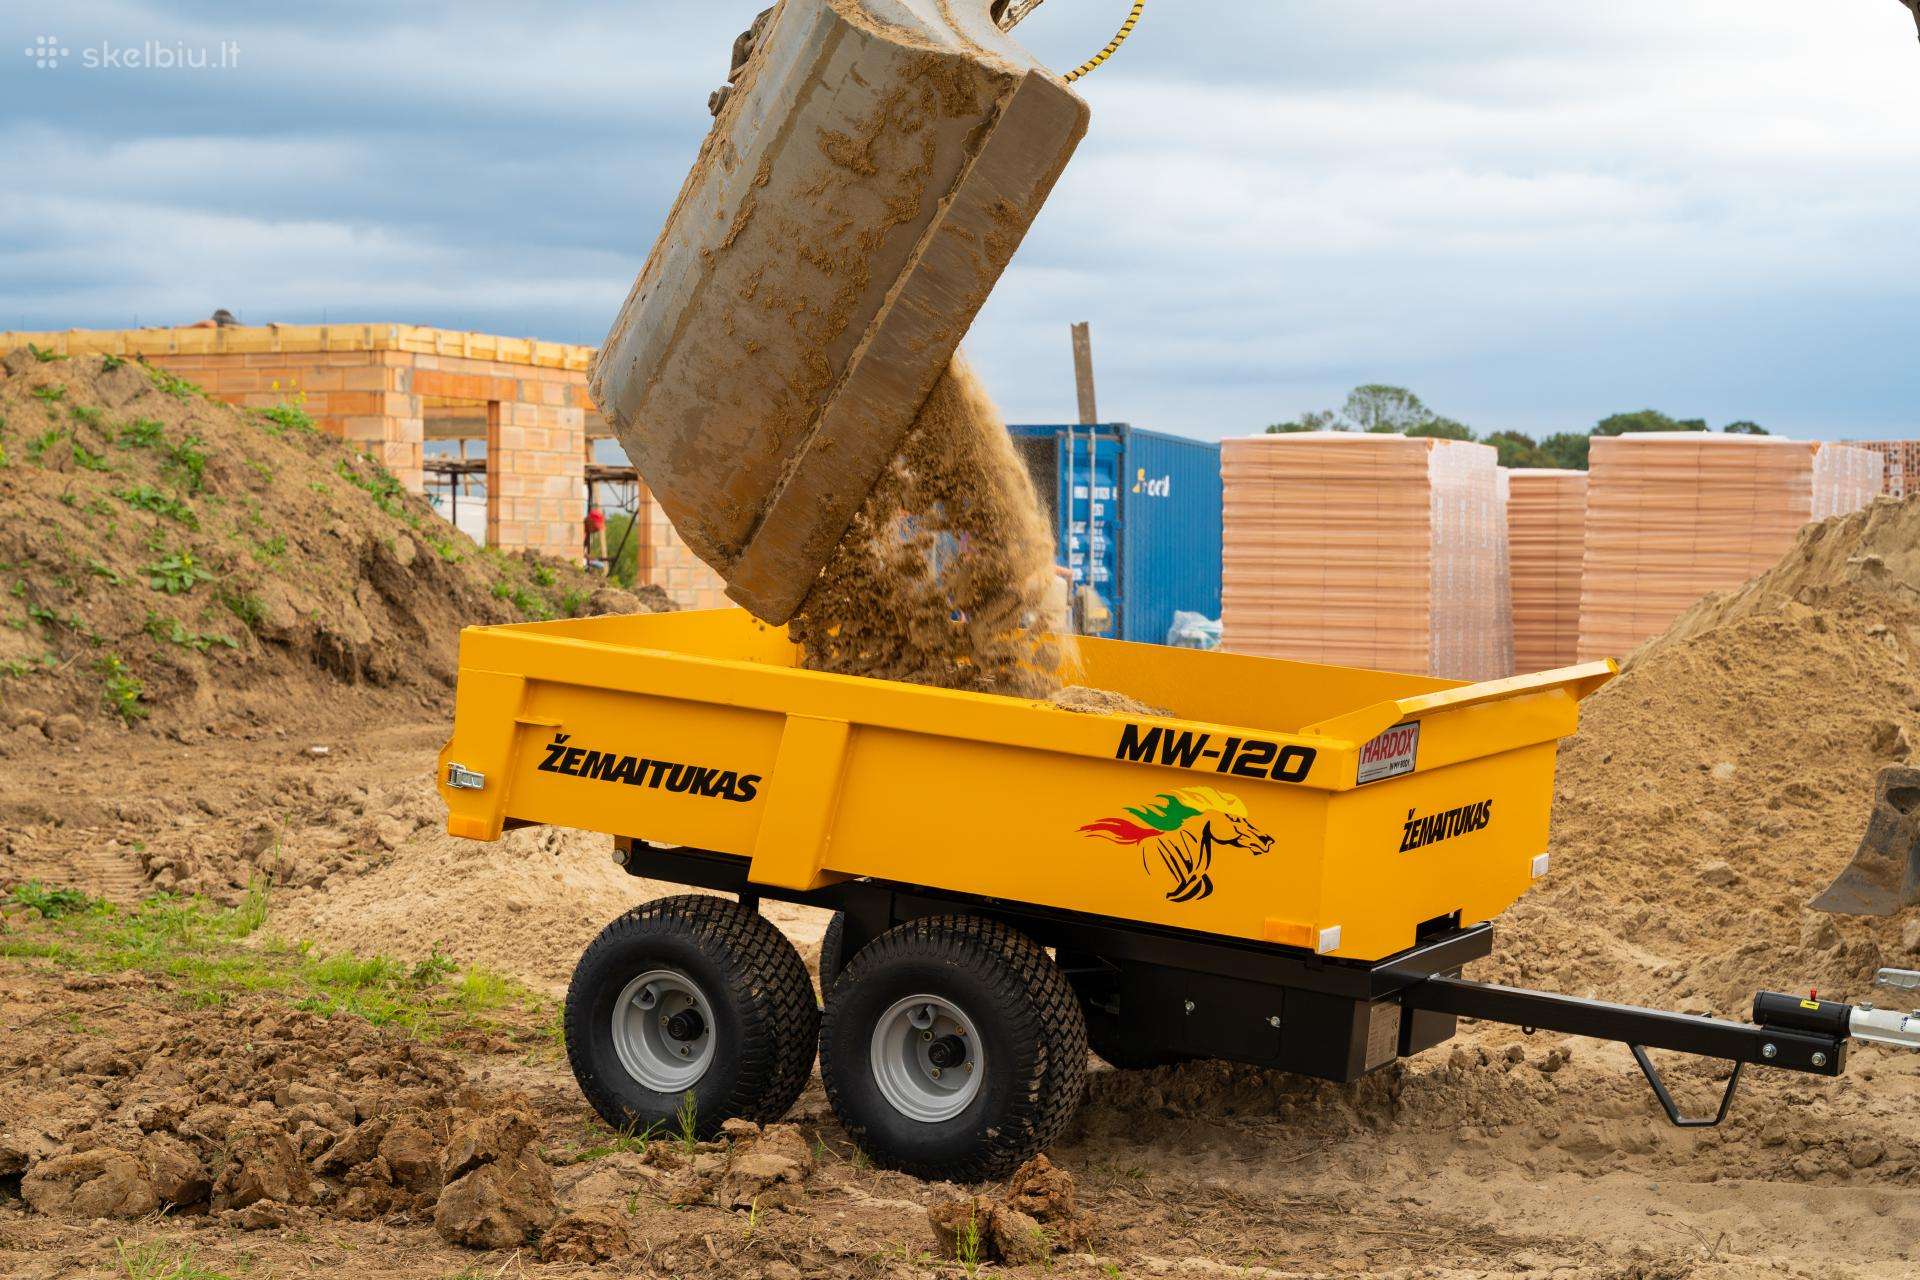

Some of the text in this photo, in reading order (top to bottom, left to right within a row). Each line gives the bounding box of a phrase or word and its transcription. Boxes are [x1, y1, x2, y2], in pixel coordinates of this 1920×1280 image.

[538, 733, 762, 803] ŽEMAITUKAS
[1116, 724, 1317, 783] MW-120
[1361, 728, 1415, 765] HARDOX
[1399, 799, 1492, 853] ŽEMAITUKAS
